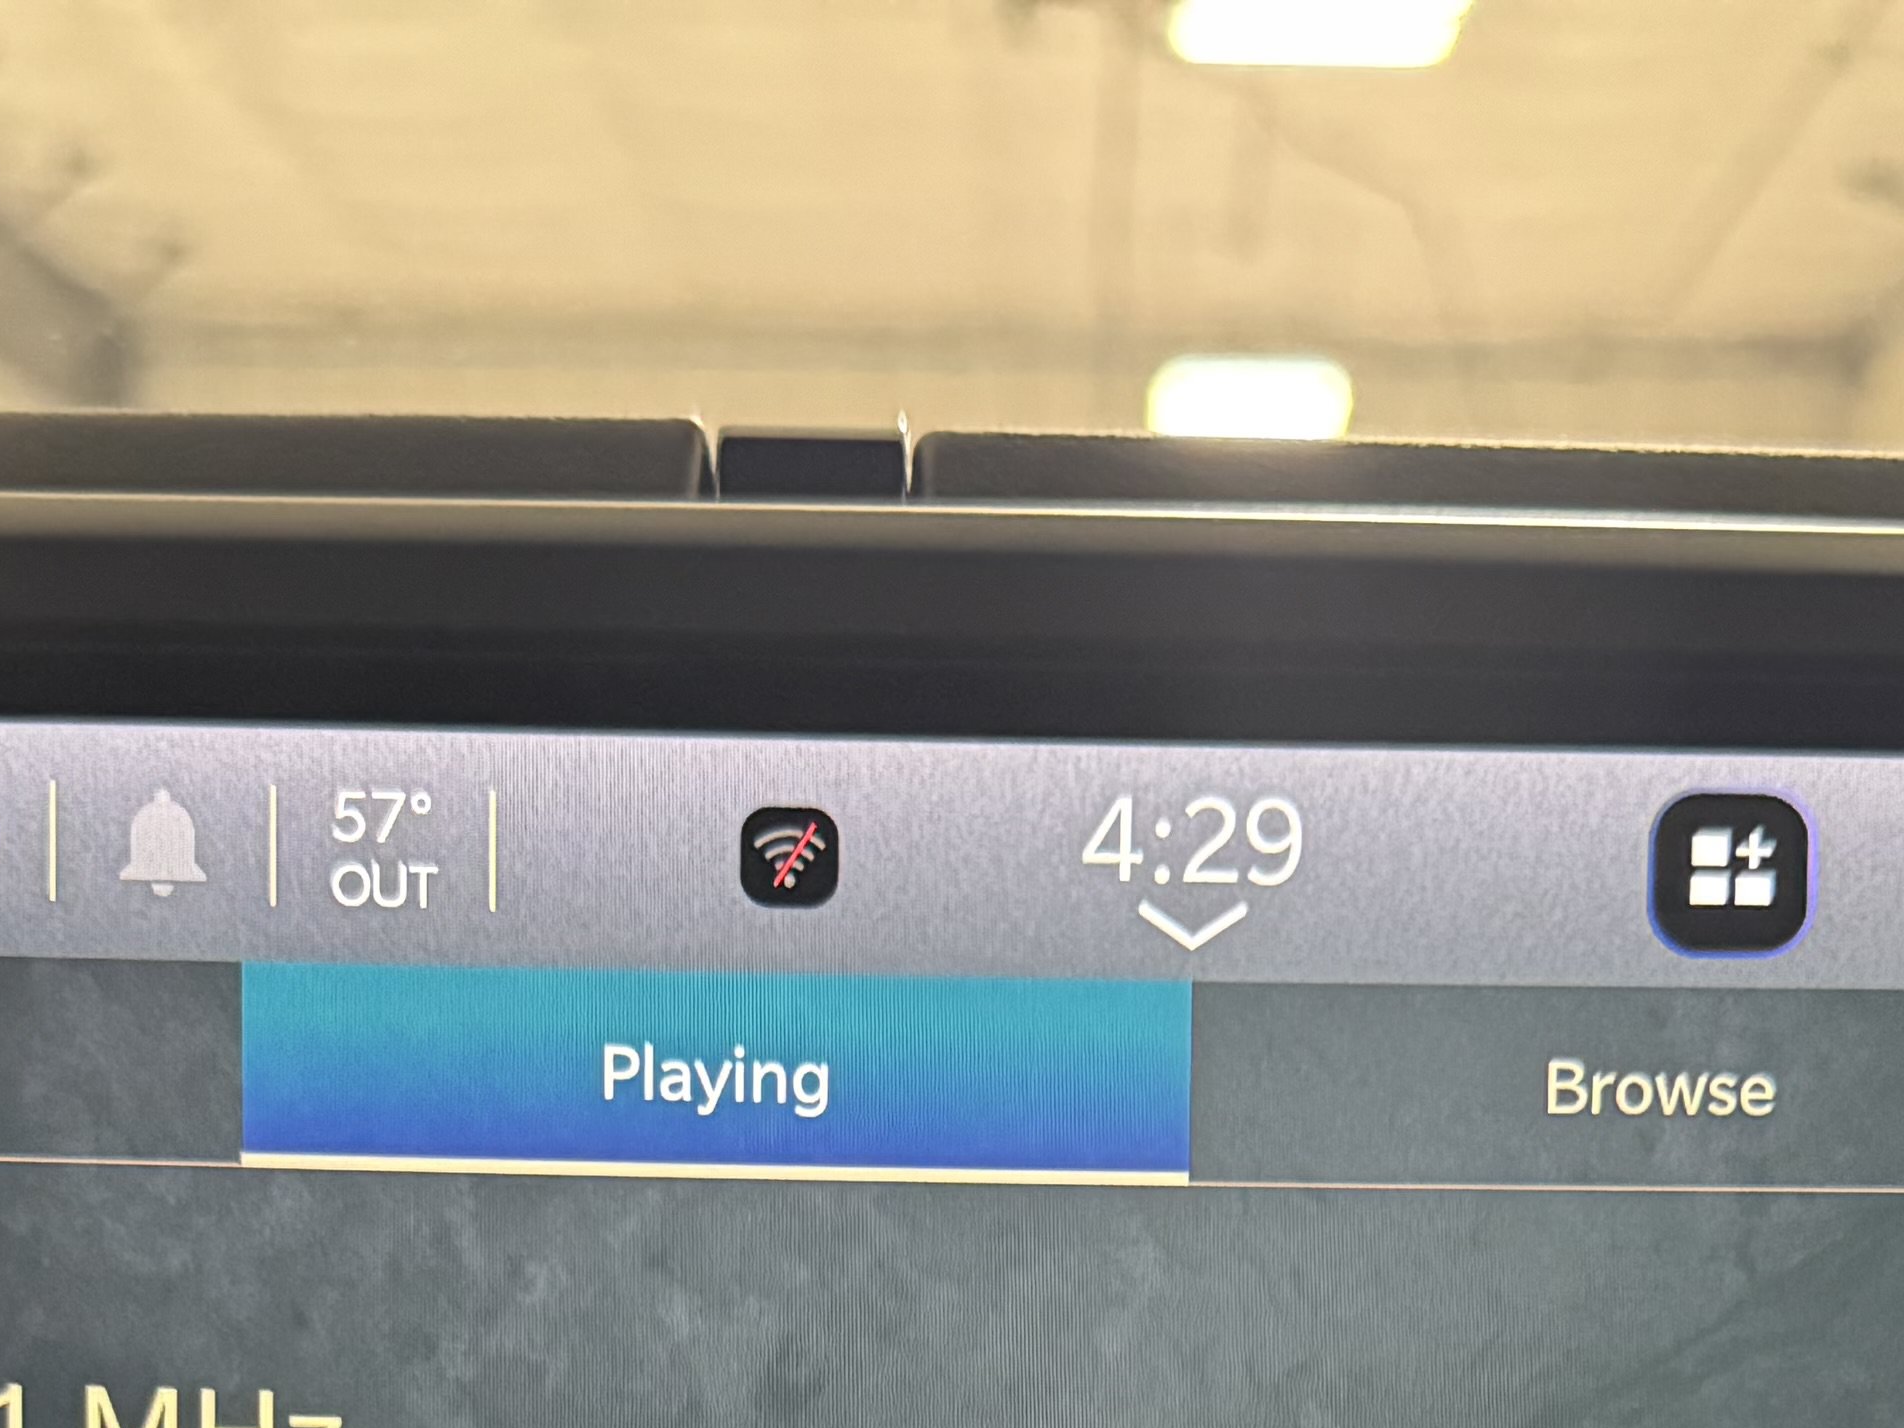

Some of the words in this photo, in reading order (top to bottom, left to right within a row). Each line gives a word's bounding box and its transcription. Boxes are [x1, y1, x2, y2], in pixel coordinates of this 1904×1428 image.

[330, 789, 433, 844] 57°
[1081, 794, 1303, 887] 4:29
[329, 861, 439, 909] OUT
[601, 1043, 831, 1118] Playing
[1546, 1057, 1778, 1118] Browse
